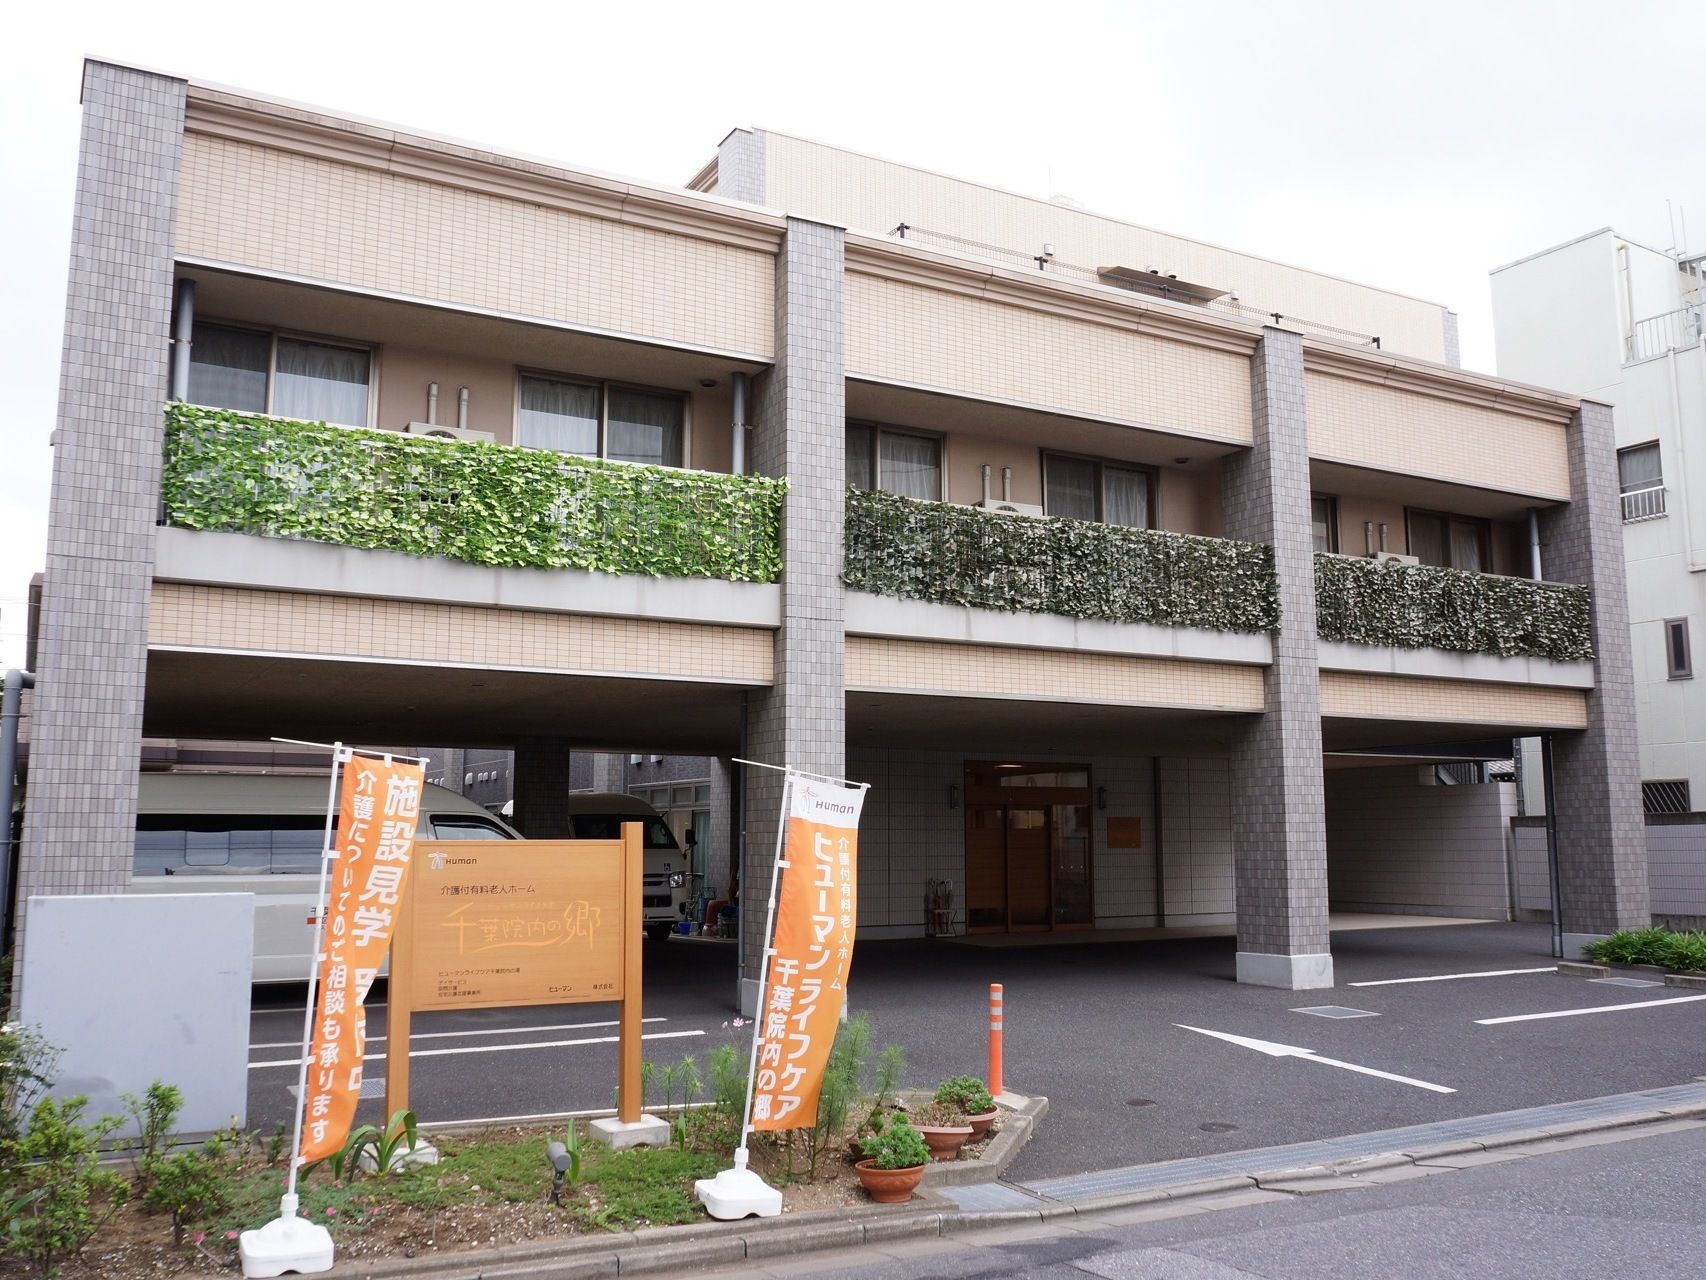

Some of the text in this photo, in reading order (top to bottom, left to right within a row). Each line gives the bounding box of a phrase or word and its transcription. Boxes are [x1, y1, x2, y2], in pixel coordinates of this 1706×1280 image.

[351, 773, 419, 947] 施設見学
[815, 800, 855, 815] Human
[441, 885, 536, 895] 介護付有料老人ホーム
[445, 857, 477, 865] Human
[829, 836, 851, 991] 介護付有料老人ホーム
[311, 769, 377, 1144] 介護についてのご相談も承ります
[440, 900, 601, 955] 千葉院内の郷
[753, 957, 799, 1121] 千葉院内の郷
